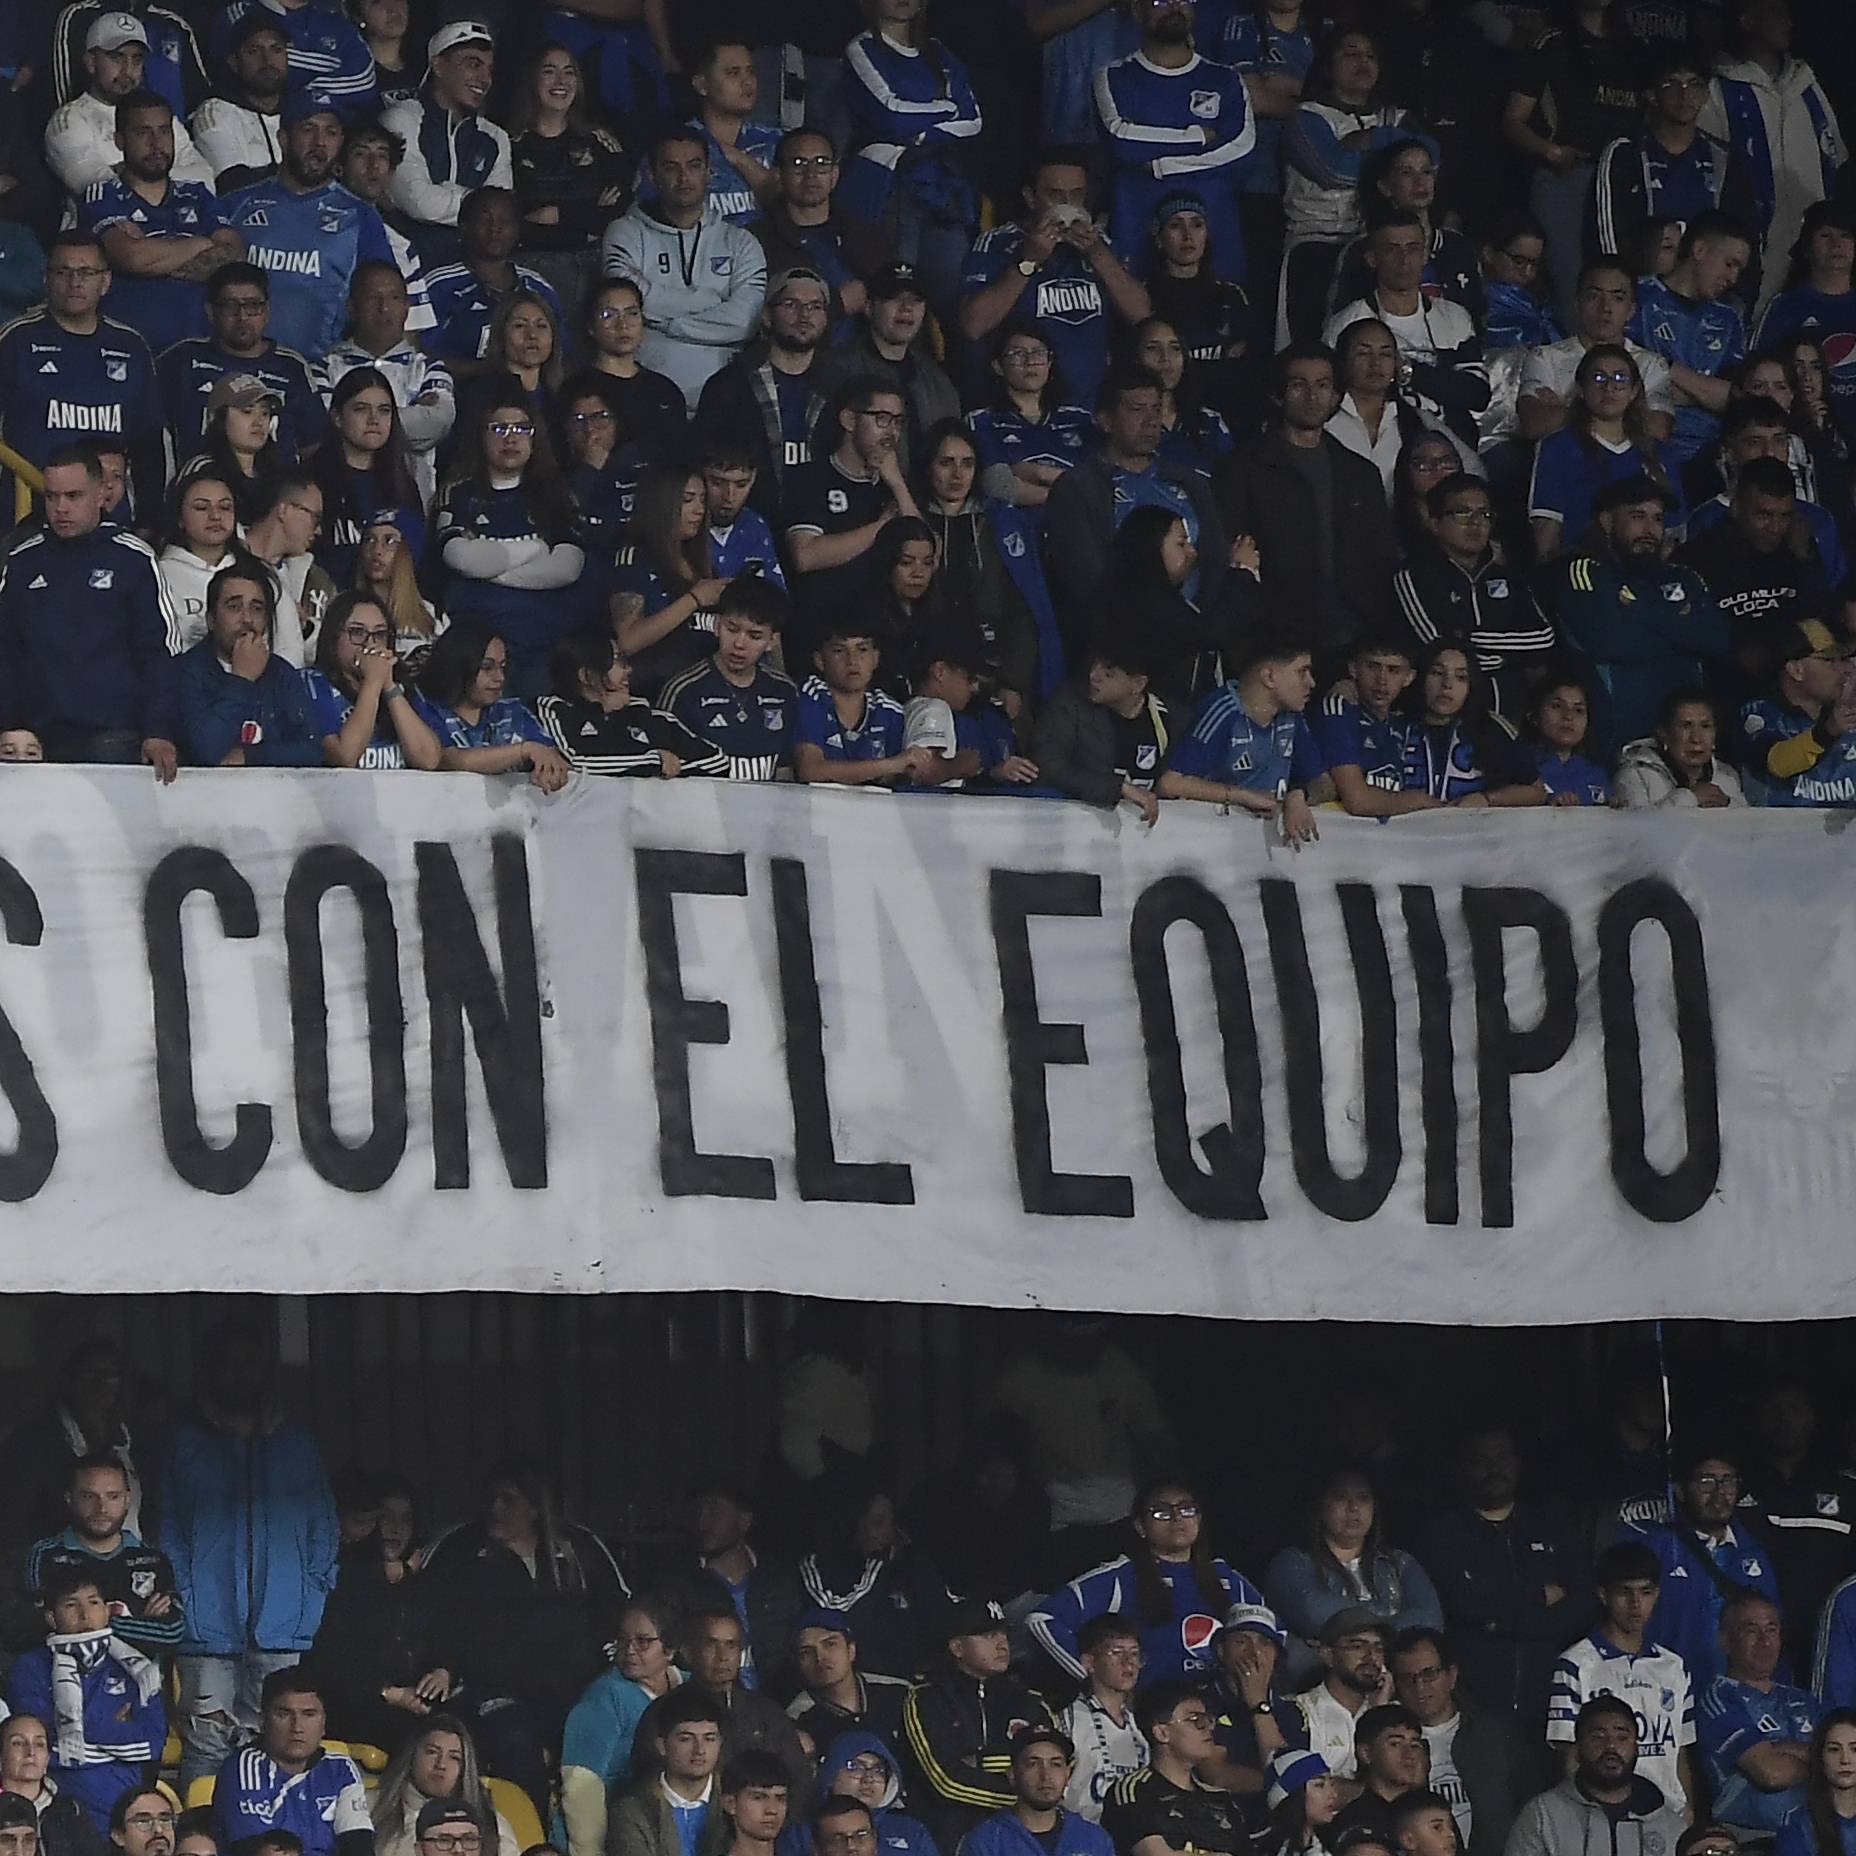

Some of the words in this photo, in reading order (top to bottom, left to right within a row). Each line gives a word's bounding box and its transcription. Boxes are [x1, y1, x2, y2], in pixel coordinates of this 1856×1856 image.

[708, 191, 755, 214] ANDI
[247, 244, 321, 278] ANDINA
[658, 253, 671, 275] 9
[1036, 286, 1101, 316] ANDINA
[47, 400, 122, 433] ANDINA
[828, 489, 849, 513] 9
[1792, 774, 1855, 802] ANDINA
[143, 831, 549, 1195] CON
[633, 847, 915, 1205] EL
[989, 862, 1722, 1229] EQUIPO
